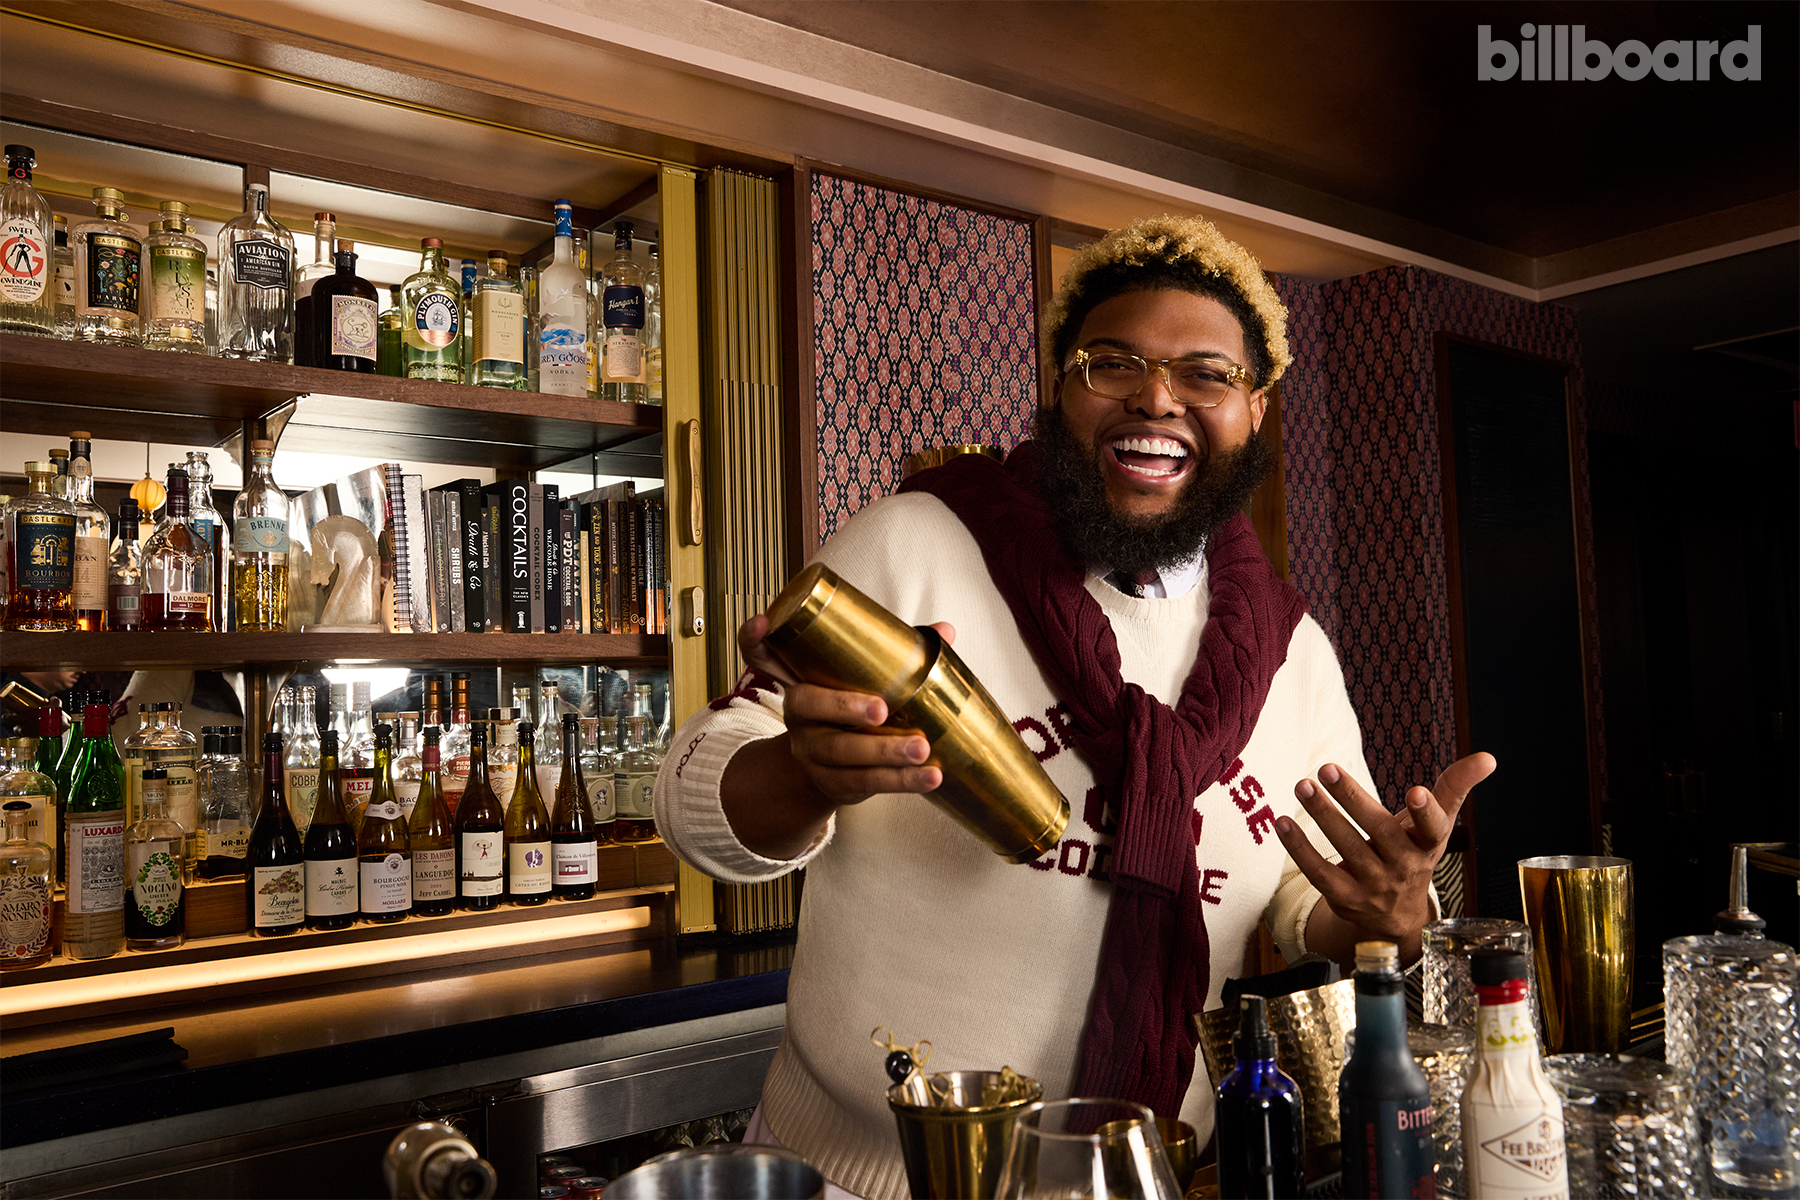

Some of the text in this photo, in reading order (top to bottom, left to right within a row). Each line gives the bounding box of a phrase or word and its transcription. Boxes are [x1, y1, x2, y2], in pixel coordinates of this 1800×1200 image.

[8, 226, 33, 235] SWEET
[96, 237, 126, 247] CASTLE
[156, 249, 184, 257] CASTLE
[239, 245, 286, 260] AVIATION
[417, 295, 458, 324] PLYMOUTH GIN
[608, 299, 635, 311] Hangar
[634, 296, 639, 305] 1
[22, 515, 57, 523] CASTLE
[250, 519, 287, 533] BRENNE
[512, 485, 528, 579] COCKTAILS
[593, 522, 601, 535] ZEN
[467, 520, 480, 556] Death
[563, 540, 573, 566] PDT
[451, 547, 461, 585] SHRUBS
[25, 570, 71, 578] BOURBON
[469, 575, 482, 591] Co
[415, 850, 454, 860] LES DARONS
[415, 868, 454, 879] LANGUEDOC
[140, 882, 177, 894] NOCINO
[418, 890, 432, 898] JEFF
[2, 900, 41, 913] AMARO
[381, 898, 407, 906] MOILLARD
[1, 909, 41, 922] NONINO
[1501, 1140, 1524, 1156] FEE
